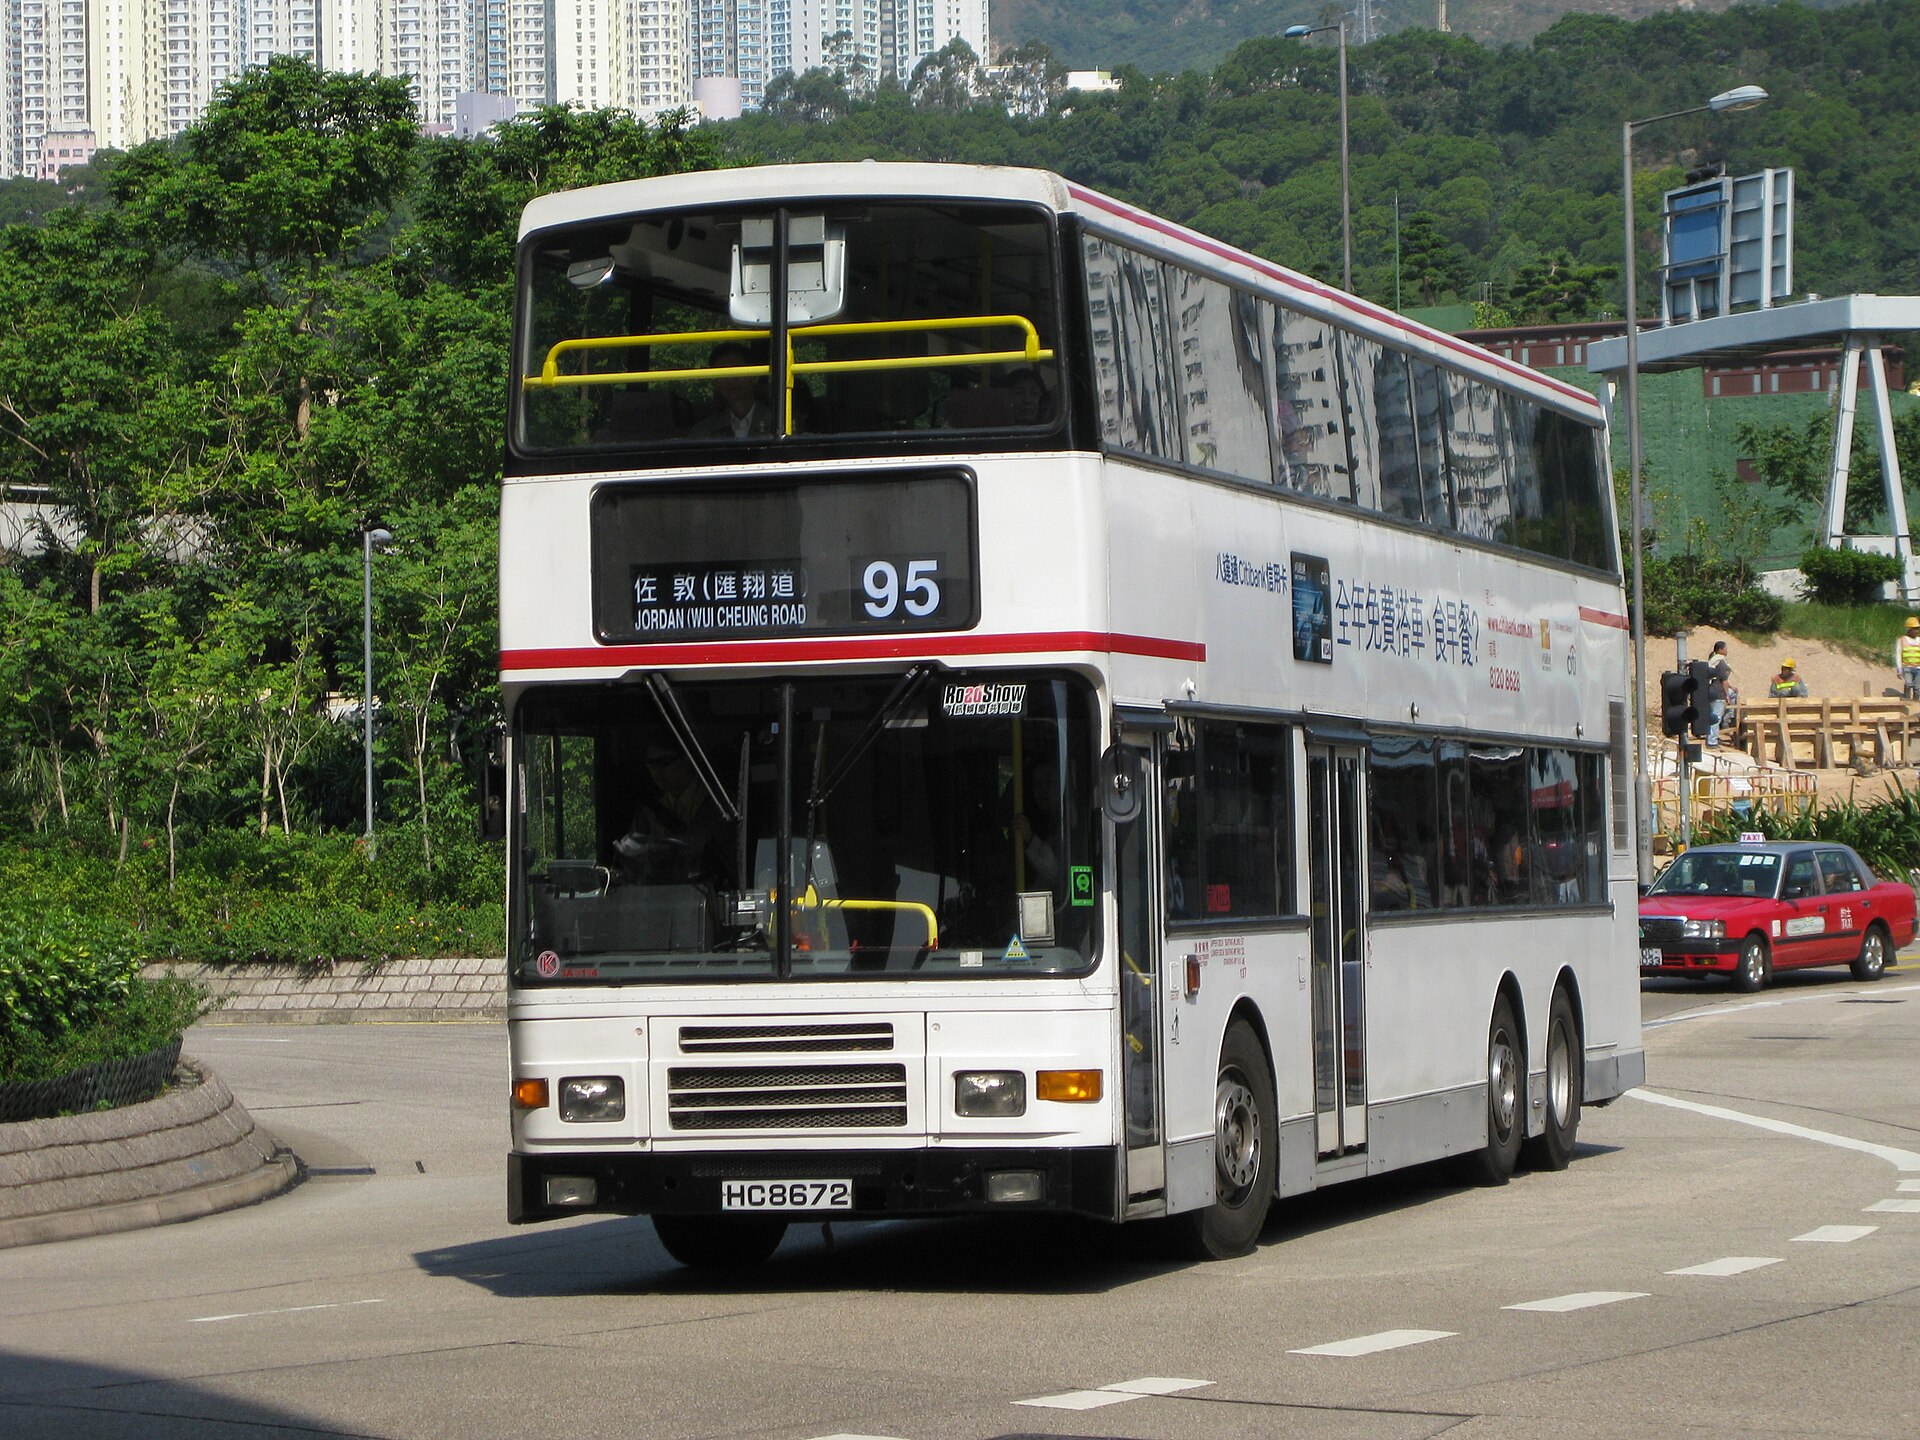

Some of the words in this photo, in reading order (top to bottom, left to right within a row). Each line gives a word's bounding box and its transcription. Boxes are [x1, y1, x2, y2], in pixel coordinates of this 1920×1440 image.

[862, 560, 941, 618] 95
[635, 608, 684, 630] JORDAN
[717, 604, 768, 627] CHEUNG
[772, 603, 806, 625] ROAD
[1742, 833, 1761, 841] TAXI
[727, 1184, 848, 1206] HC8672
